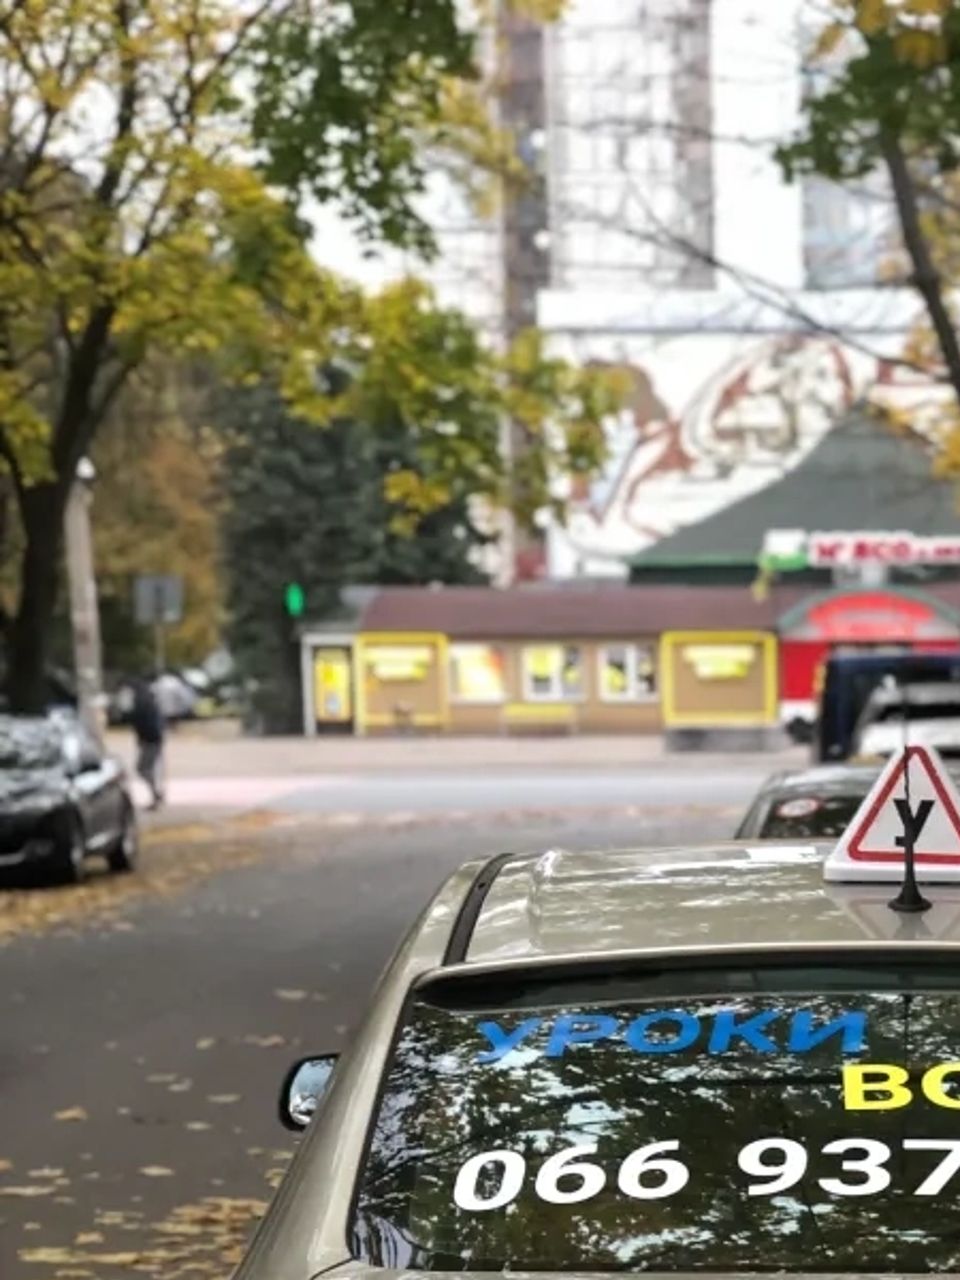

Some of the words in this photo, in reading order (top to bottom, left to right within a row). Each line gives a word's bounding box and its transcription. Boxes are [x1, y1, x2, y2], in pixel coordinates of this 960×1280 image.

[893, 798, 935, 848] У
[475, 1009, 870, 1064] УРОКИ
[453, 1139, 691, 1212] 066
